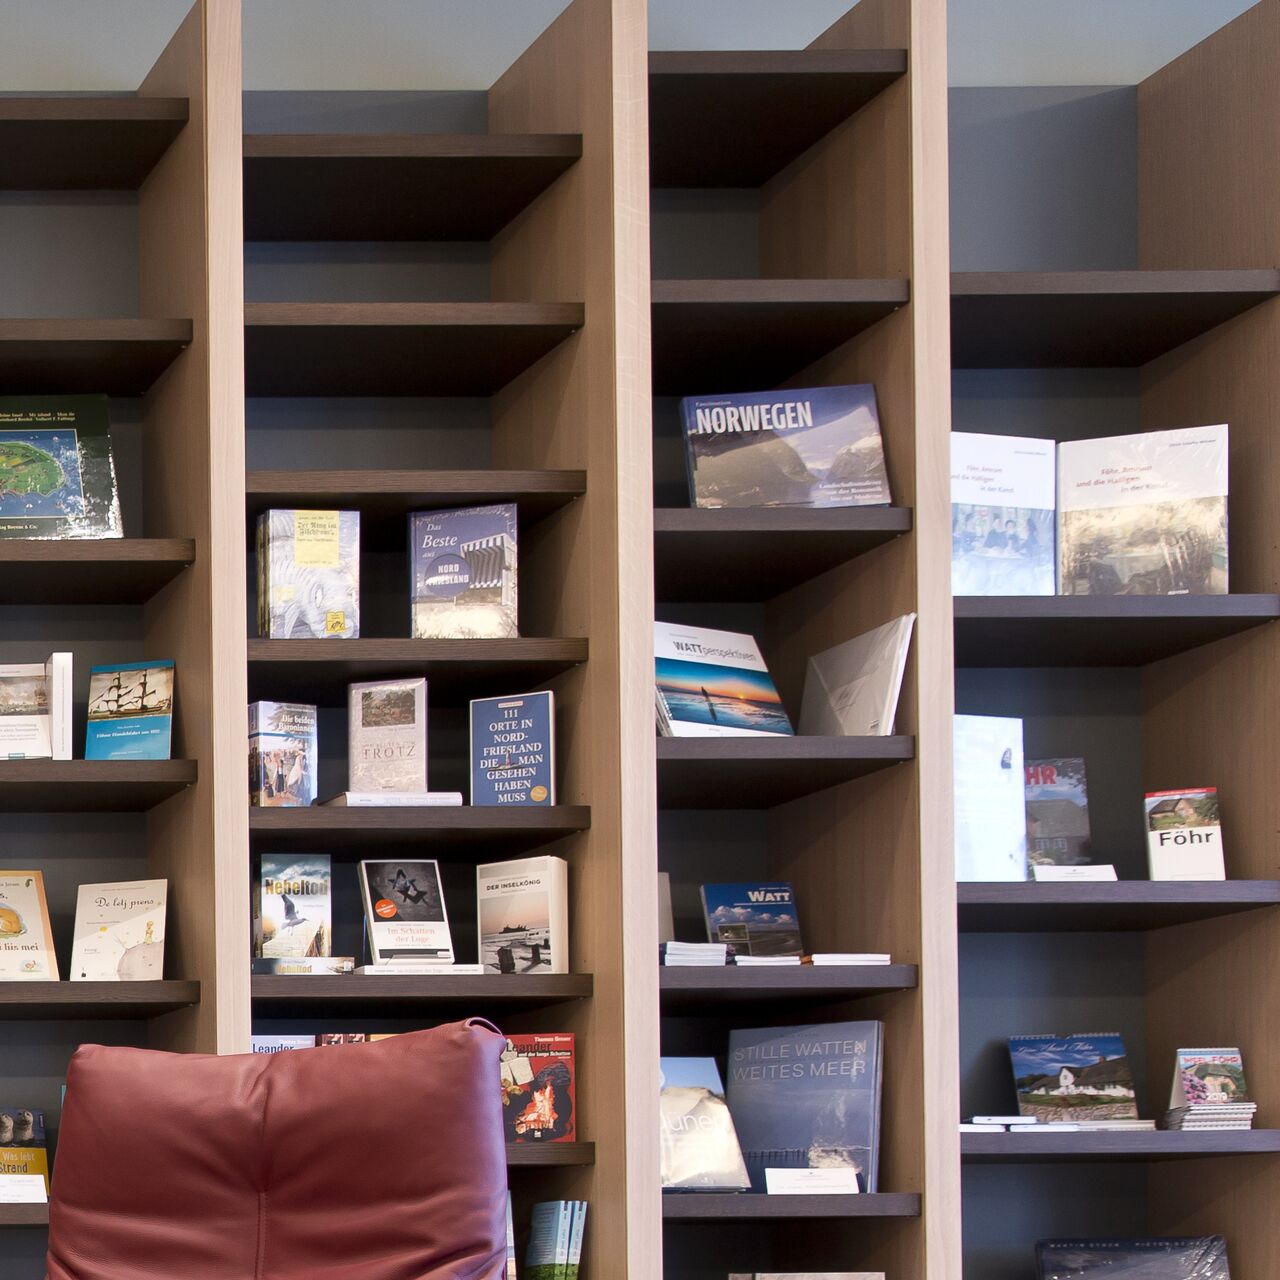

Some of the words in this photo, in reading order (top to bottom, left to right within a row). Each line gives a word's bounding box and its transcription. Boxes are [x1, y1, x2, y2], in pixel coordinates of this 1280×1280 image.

[695, 401, 814, 435] NORWEGEN
[426, 523, 442, 532] Das
[422, 534, 458, 549] Beste
[437, 563, 460, 574] NORD
[281, 714, 293, 722] Die
[294, 715, 315, 724] beiden
[503, 709, 519, 719] 111
[488, 720, 519, 732] ORTE
[521, 719, 534, 730] IN
[493, 732, 529, 744] NORD-
[363, 745, 416, 760] TROTZ
[483, 742, 543, 757] FRIESLAND
[479, 757, 499, 769] DIE
[518, 754, 544, 766] MAN
[486, 767, 537, 780] GESEHEN
[1026, 766, 1057, 786] HR
[494, 779, 532, 791] HABEN
[497, 791, 527, 804] MUSS
[1159, 830, 1213, 847] Föhr
[265, 879, 329, 895] Nebeltod
[500, 879, 542, 891] INSELKÖNIG
[95, 897, 110, 908] De
[387, 927, 399, 935] Im
[400, 927, 436, 936] Schatten
[21, 942, 39, 951] mei
[252, 1043, 295, 1054] Leander
[506, 1043, 553, 1053] Leander
[734, 1044, 790, 1062] STILLE
[795, 1039, 867, 1057] WATTEN
[733, 1063, 804, 1081] WEITES
[809, 1060, 866, 1077] MEER
[3, 1152, 19, 1161] Was
[19, 1151, 36, 1161] lebt
